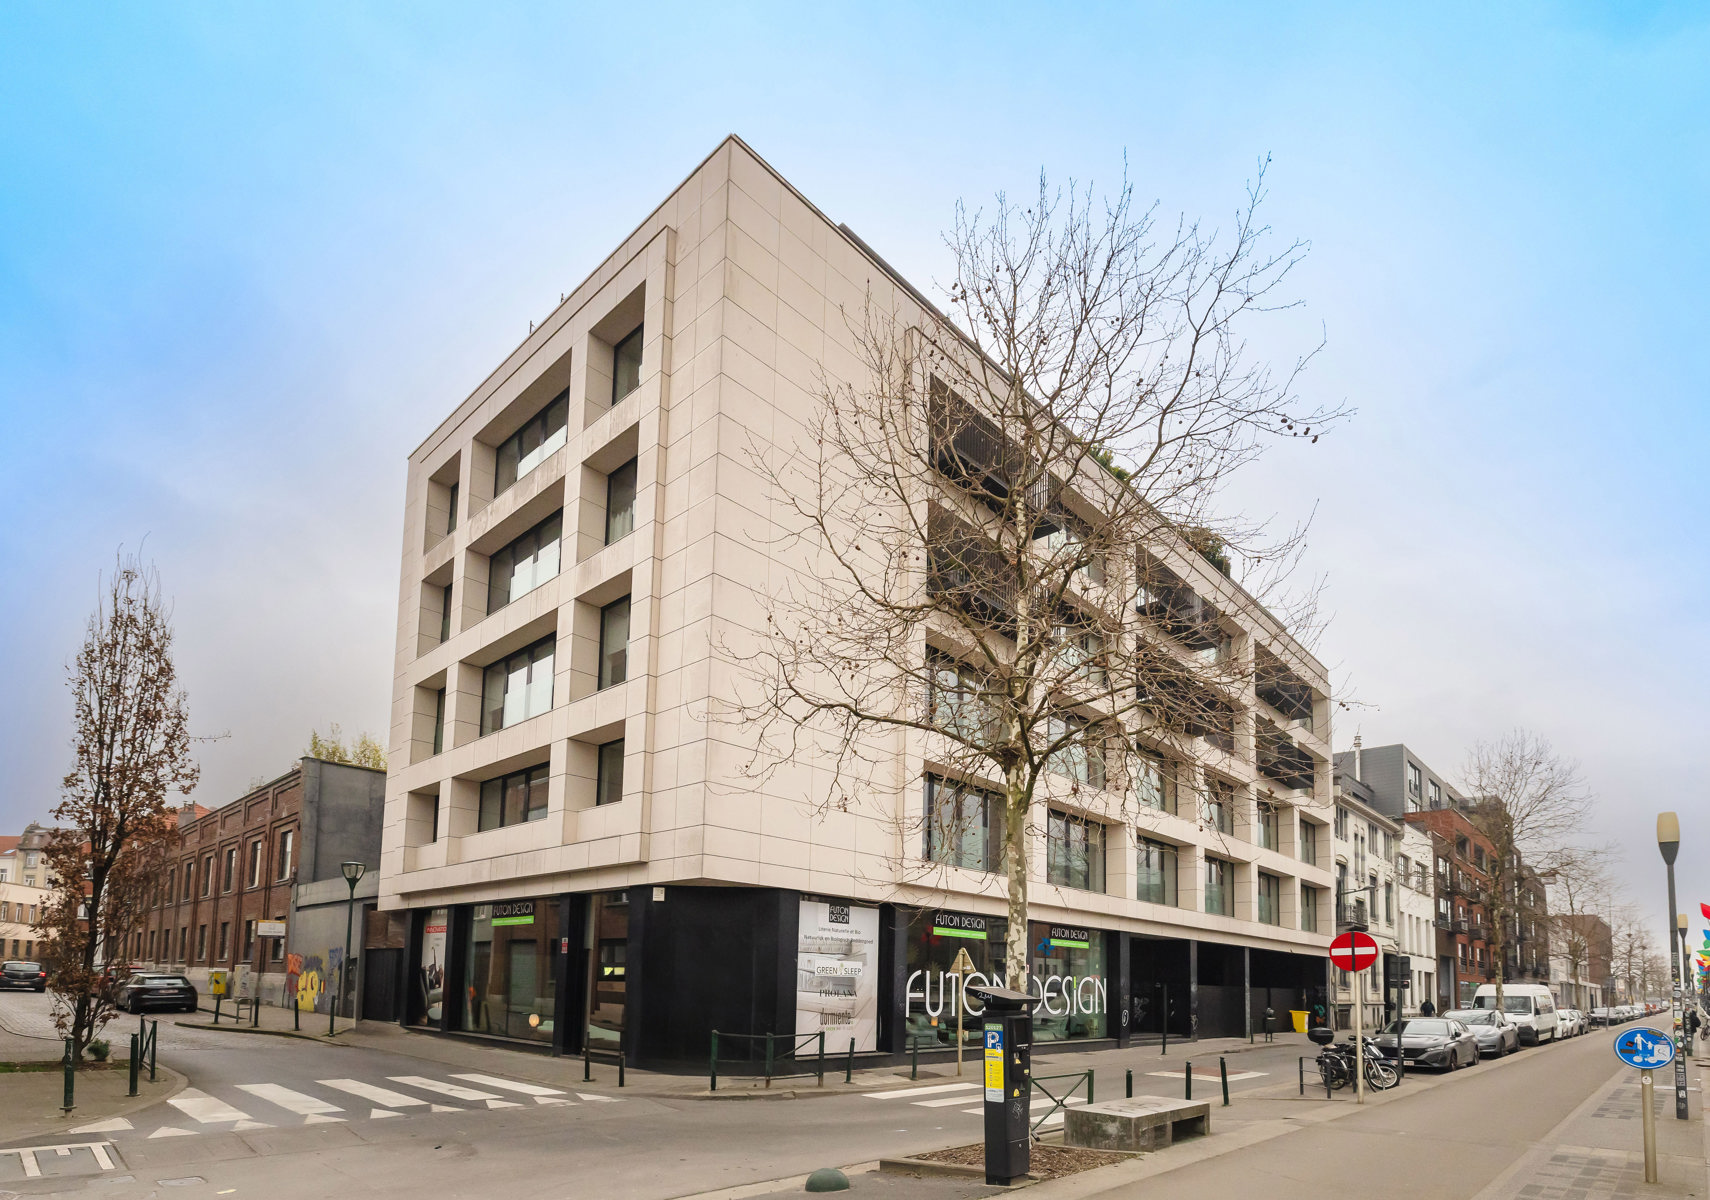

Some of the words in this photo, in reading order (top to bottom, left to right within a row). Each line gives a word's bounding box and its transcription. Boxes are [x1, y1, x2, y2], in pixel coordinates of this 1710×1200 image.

[493, 904, 511, 916] FUTON
[512, 902, 533, 915] DESIGN
[829, 905, 849, 915] FUTON
[829, 913, 849, 923] DESIGN
[935, 913, 960, 927] FUTON
[961, 916, 986, 930] DESIGN
[1051, 927, 1070, 938] FUTON
[1070, 929, 1088, 940] DESIGN
[816, 966, 838, 975] GREEN
[843, 967, 862, 976] SLEEP
